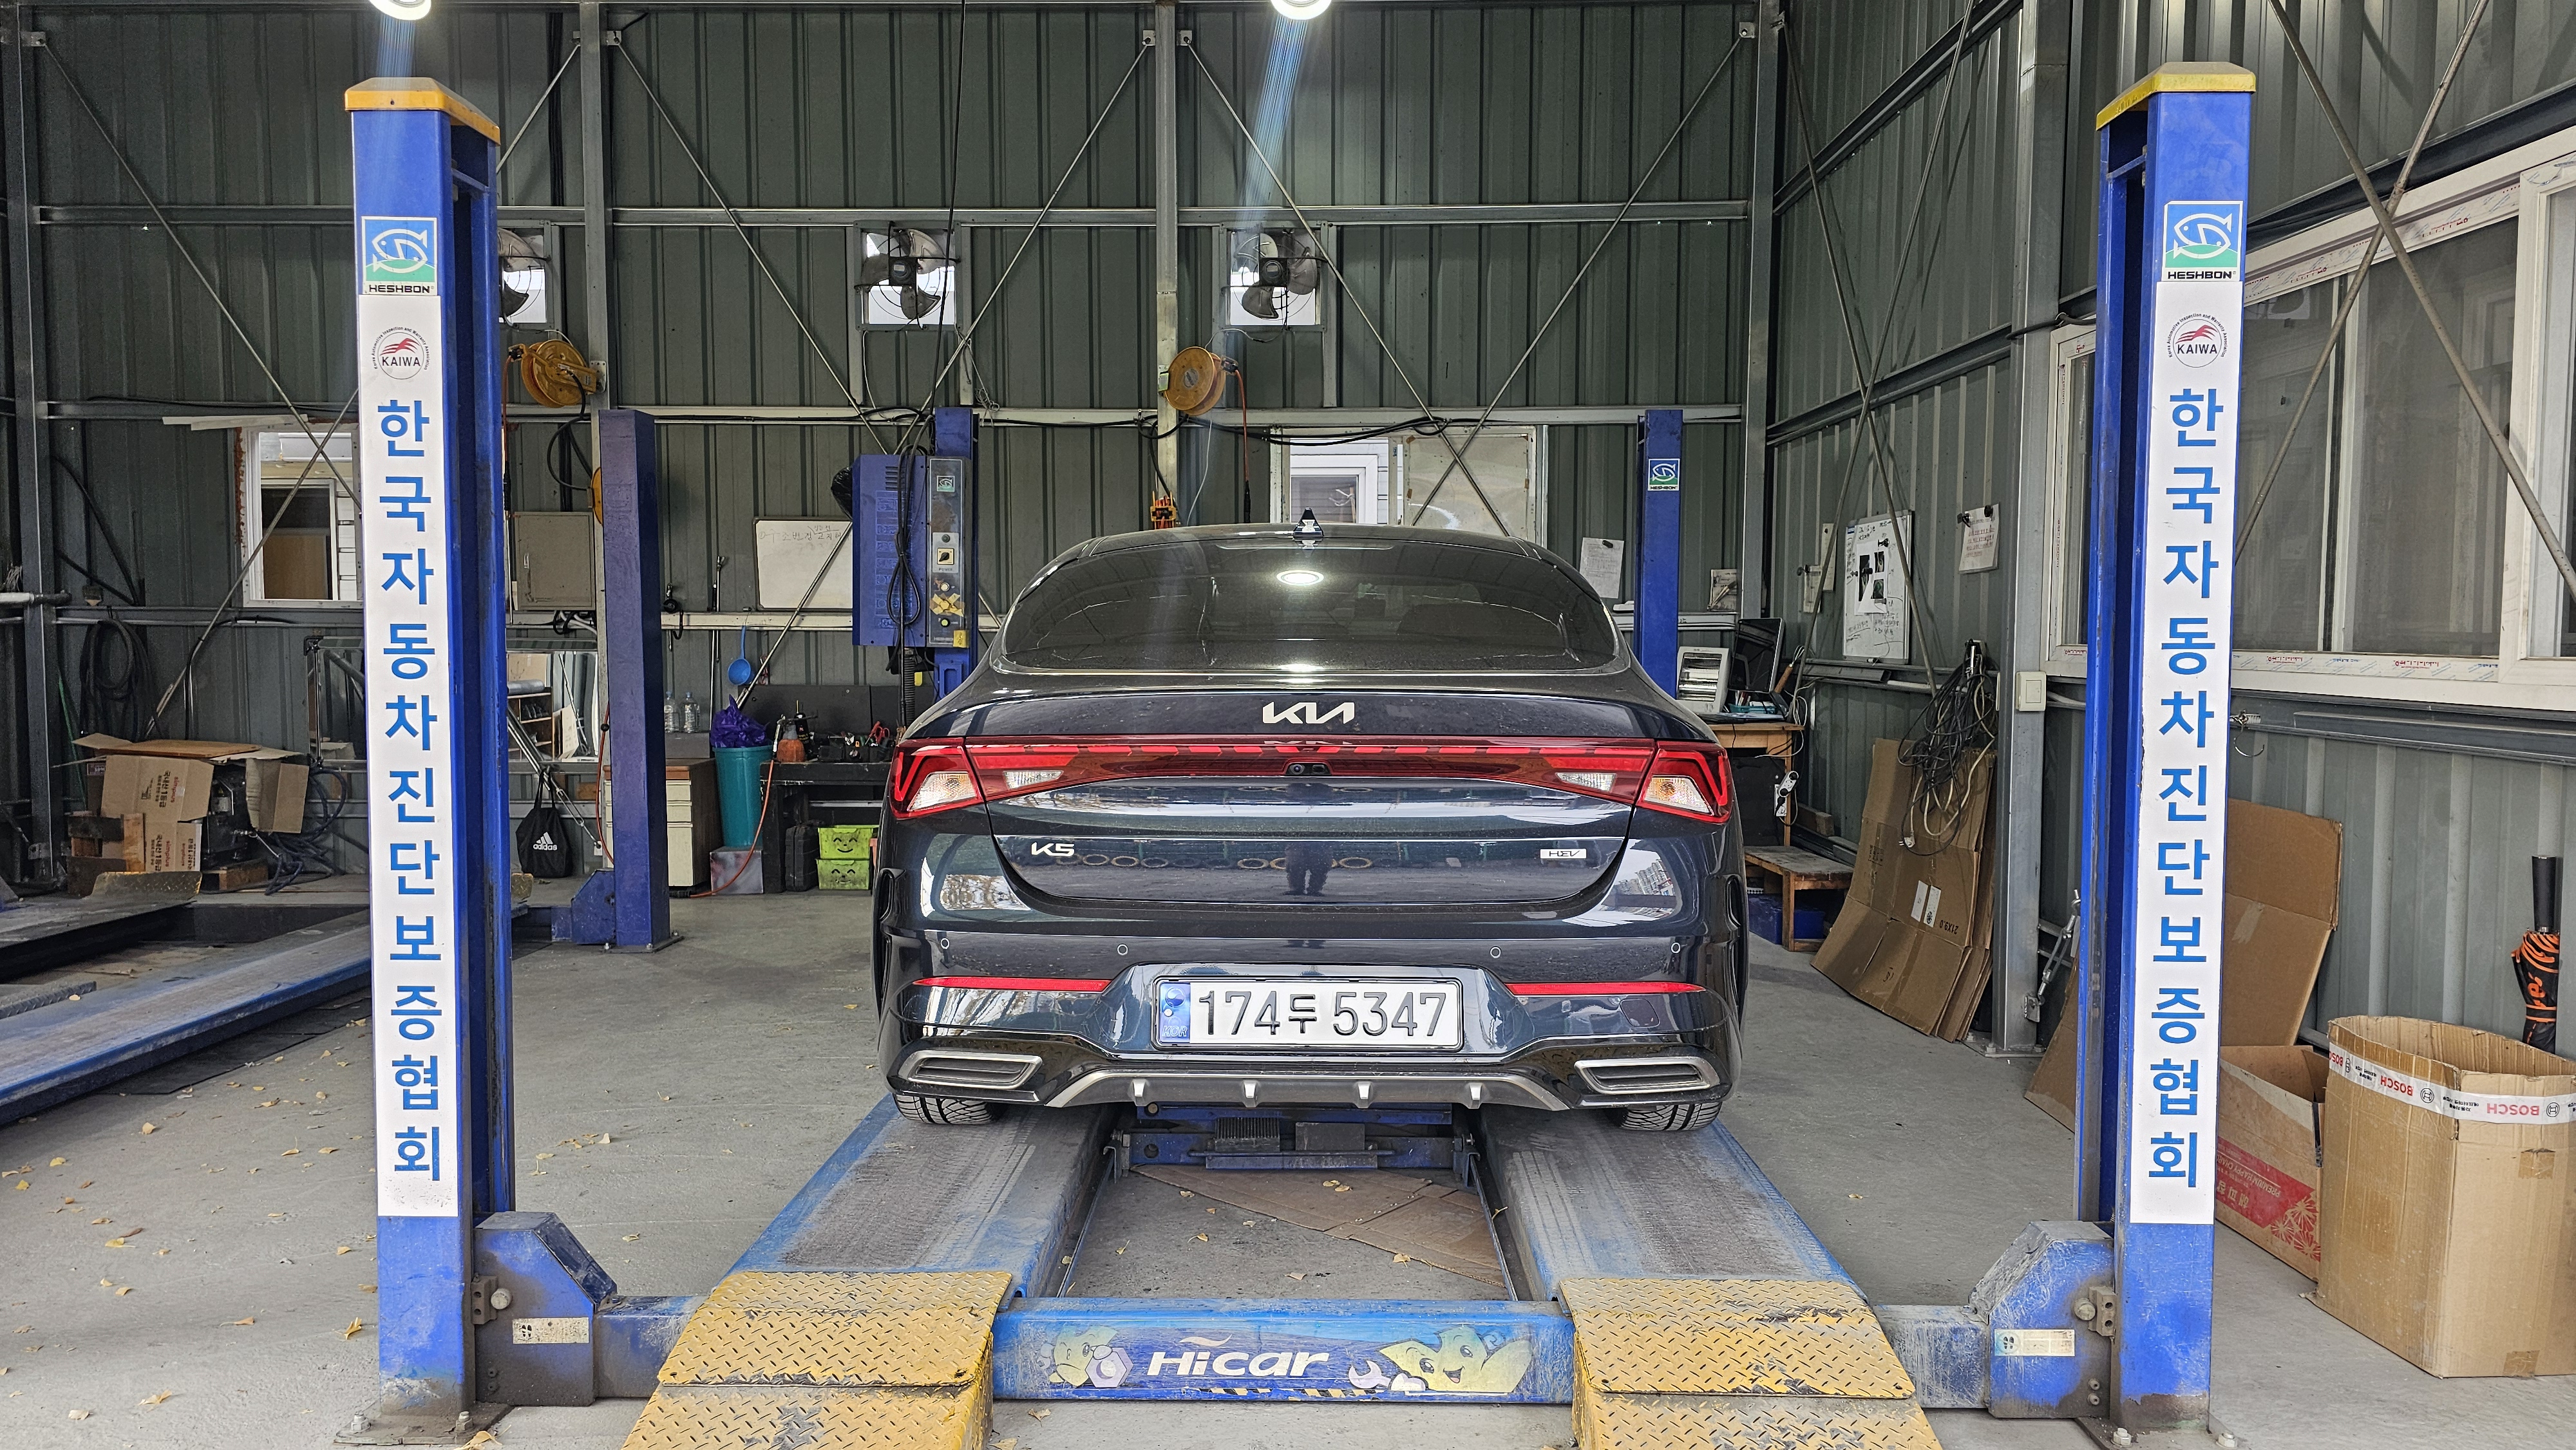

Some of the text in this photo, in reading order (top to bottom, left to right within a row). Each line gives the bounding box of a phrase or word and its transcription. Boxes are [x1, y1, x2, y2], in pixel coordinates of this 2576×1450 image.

[369, 285, 430, 293] HESHBON
[2179, 313, 2201, 322] Inspection
[2177, 344, 2217, 354] KAIWA
[382, 356, 421, 366] KAIWA
[1262, 701, 1355, 725] KIA
[1030, 842, 1075, 858] K5
[1939, 919, 1959, 934] 21X9.0
[1198, 990, 1446, 1037] 174두 5347
[1161, 1025, 1188, 1037] KOR
[2380, 1075, 2414, 1097] BOSCH
[2486, 1103, 2540, 1116] BOSCH
[2233, 1165, 2253, 1181] HAPPY
[2251, 1176, 2281, 1198] PREMIUM
[1146, 1351, 1330, 1377] Hicar
